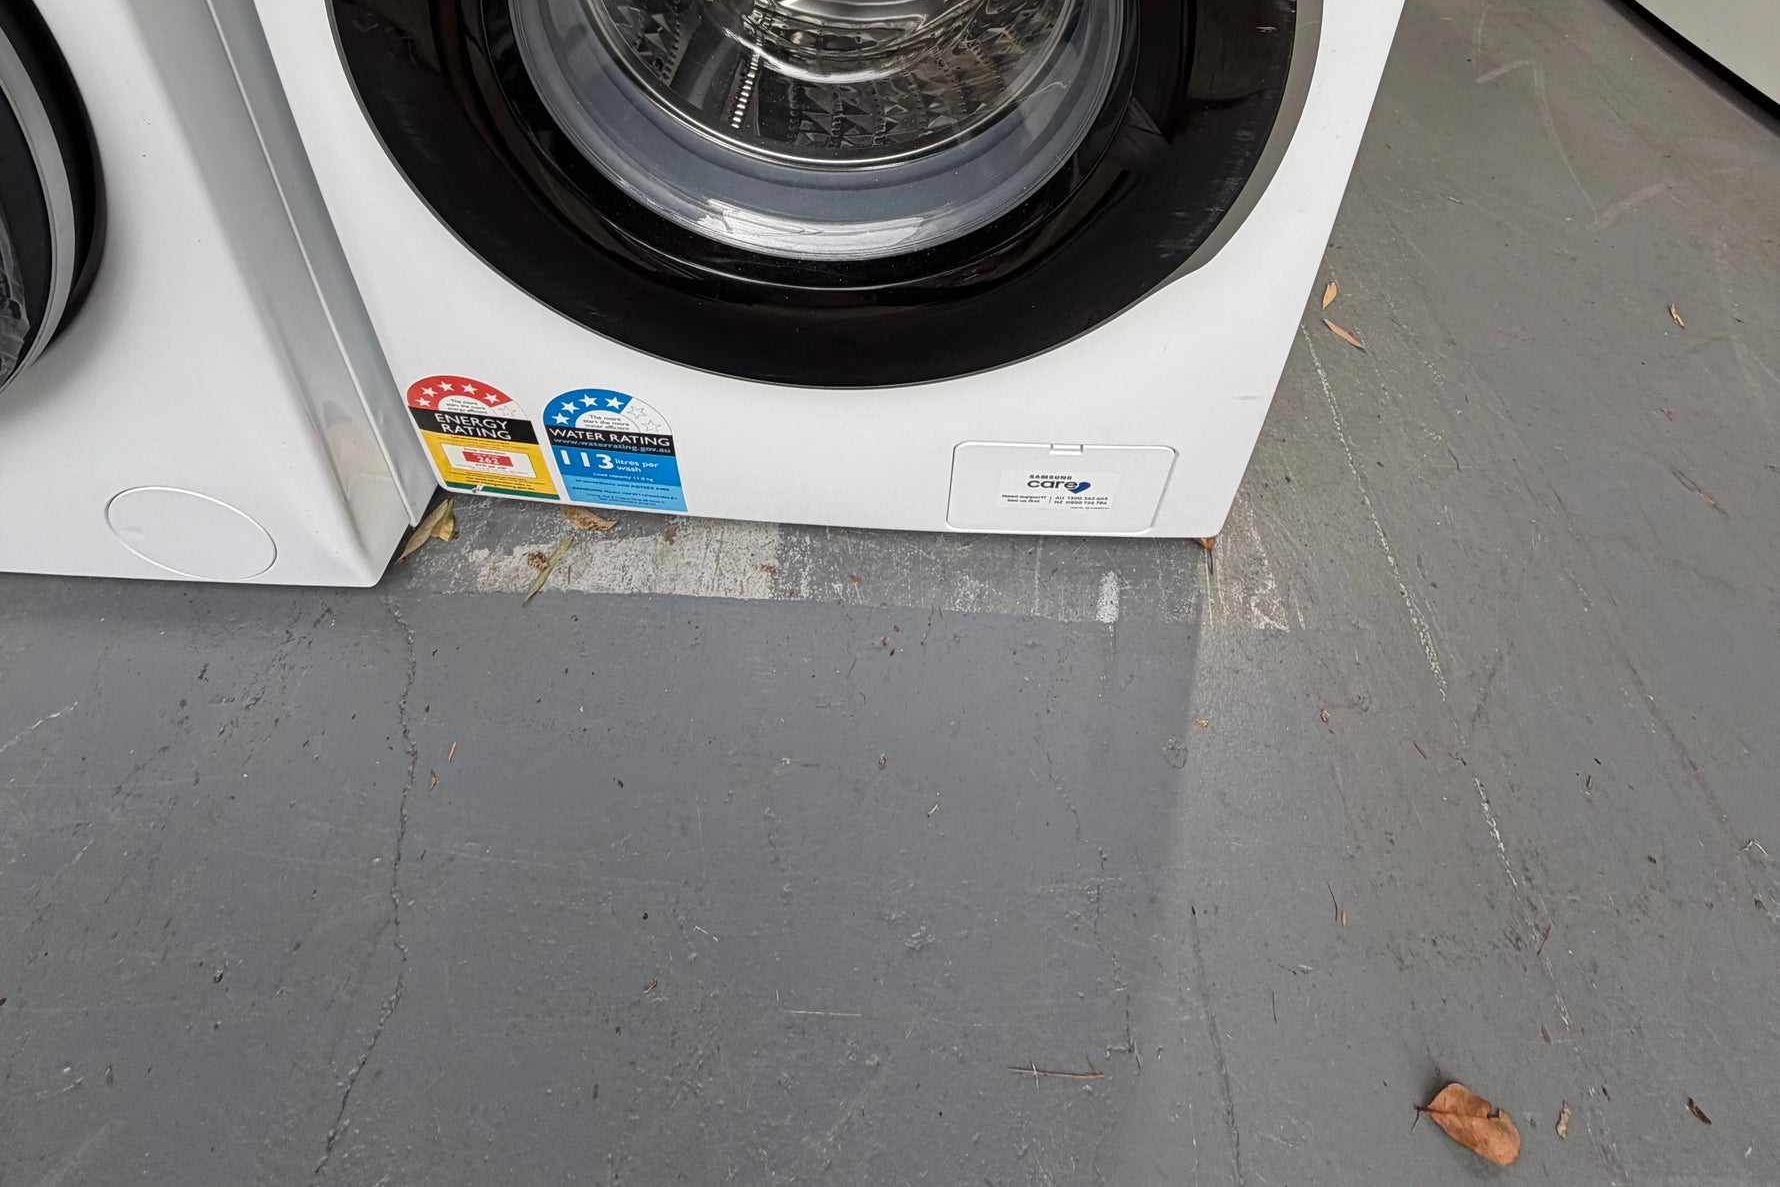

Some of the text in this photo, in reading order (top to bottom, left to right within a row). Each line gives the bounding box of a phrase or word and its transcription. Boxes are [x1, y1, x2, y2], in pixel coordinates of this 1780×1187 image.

[434, 413, 508, 430] ENERGY
[441, 423, 511, 440] RATING
[549, 428, 671, 446] WATER RATING
[553, 438, 671, 453] www.waterrating.gov.au
[477, 456, 500, 464] 262
[560, 450, 614, 470] 113
[615, 458, 639, 466] litres
[617, 465, 641, 473] wash
[1027, 480, 1078, 488] care
